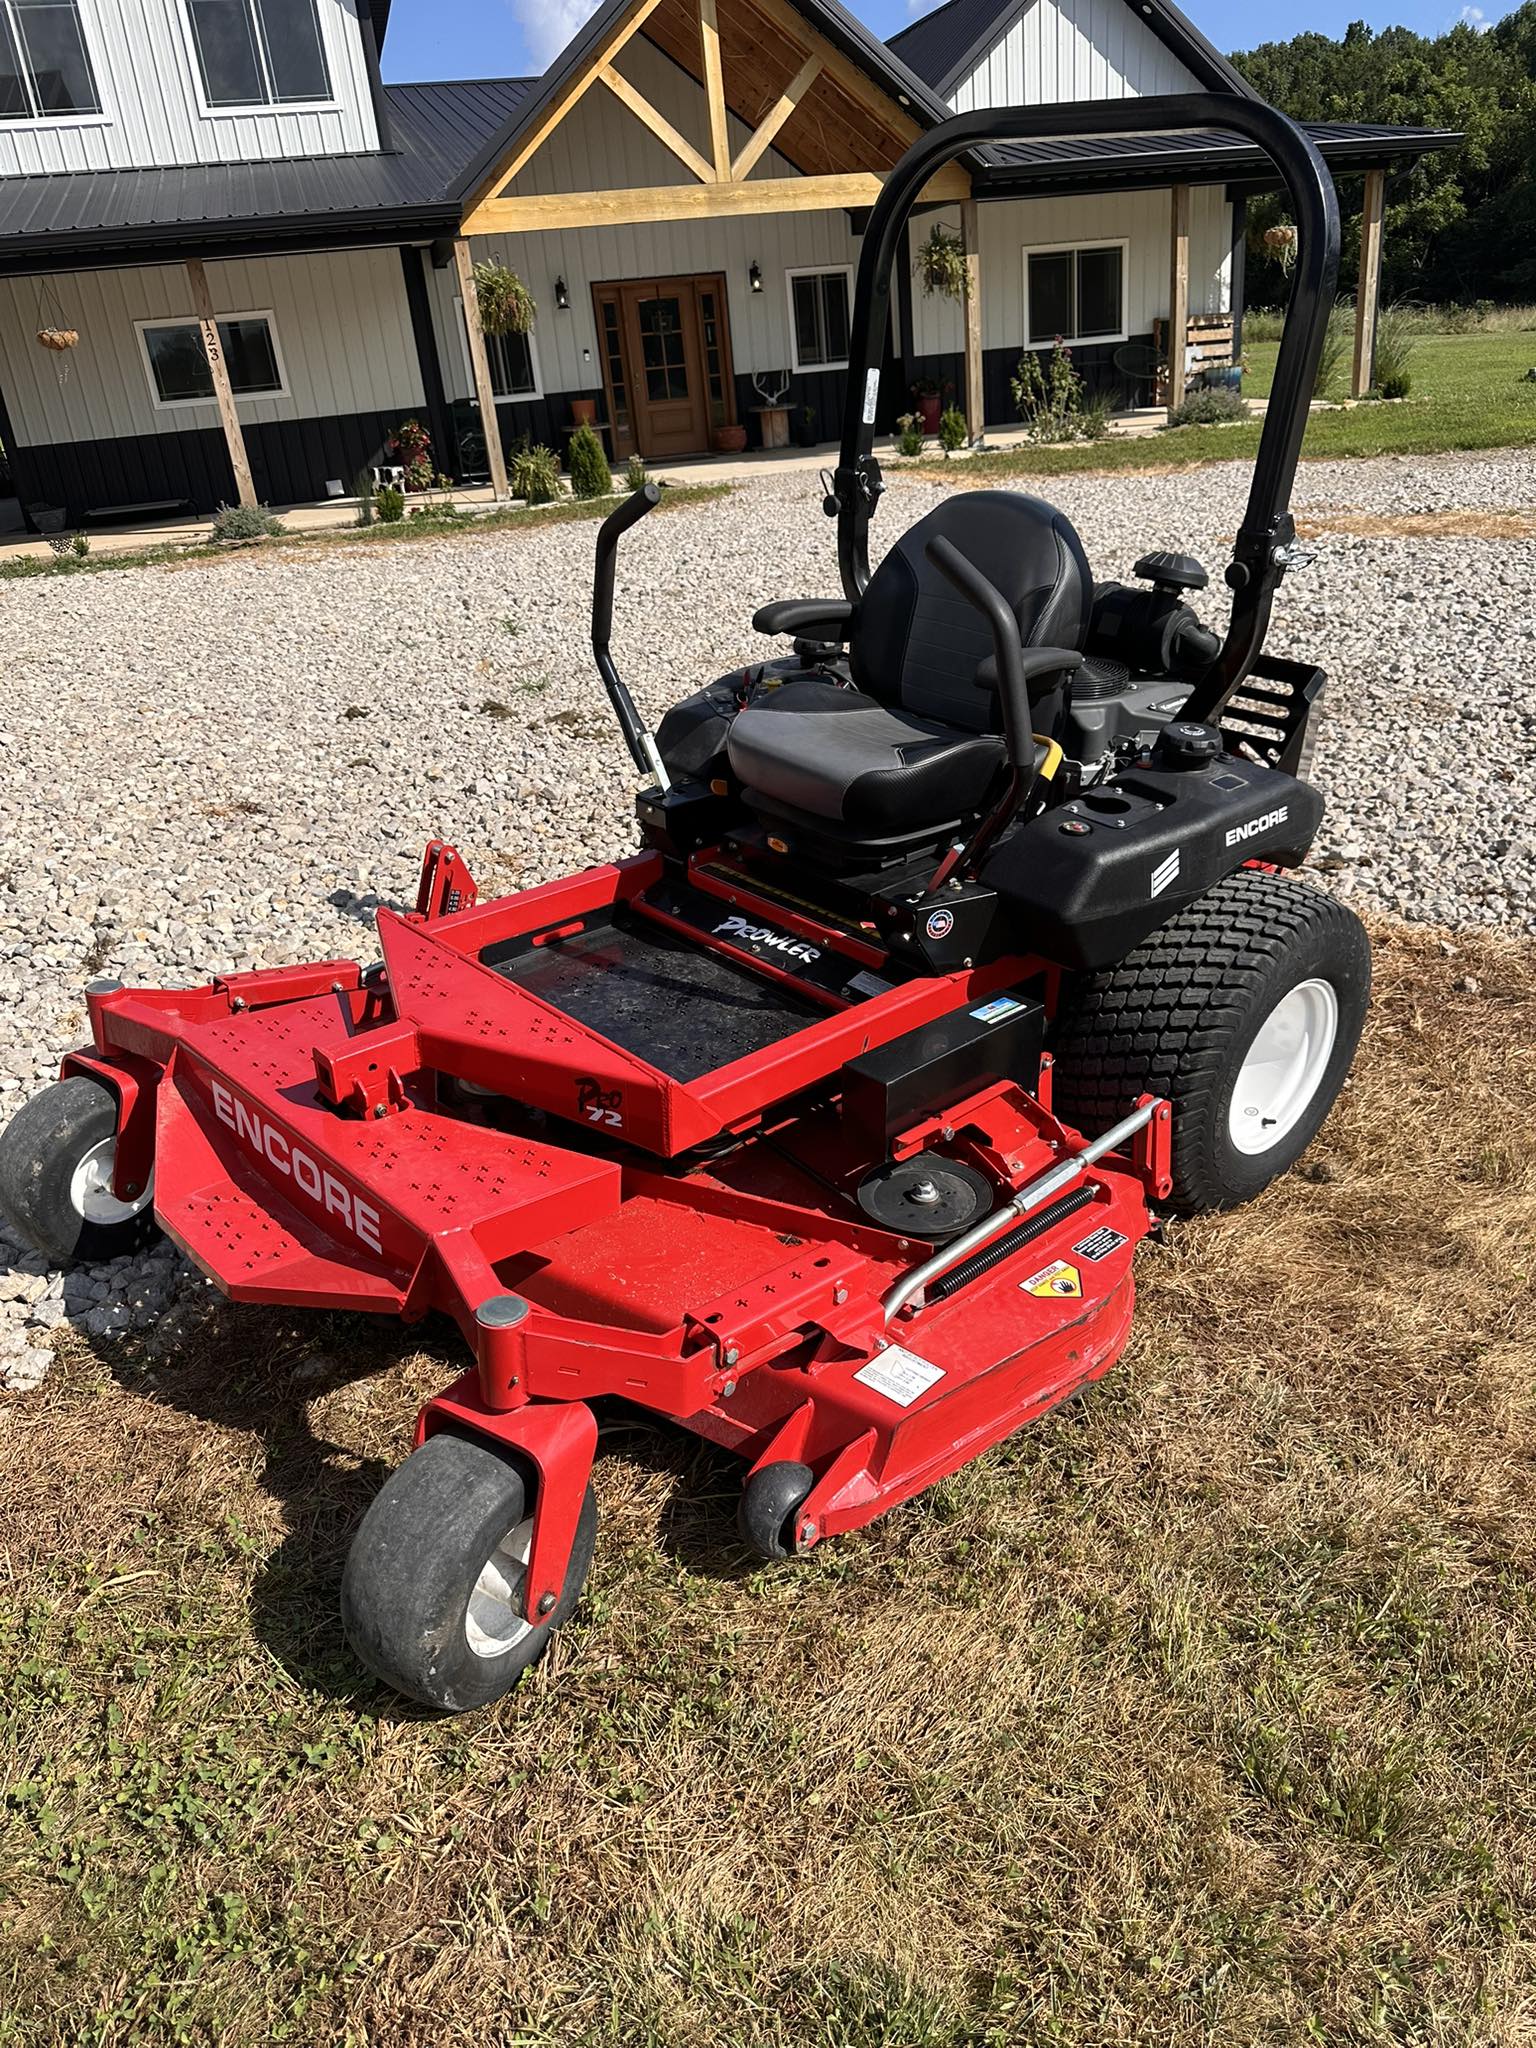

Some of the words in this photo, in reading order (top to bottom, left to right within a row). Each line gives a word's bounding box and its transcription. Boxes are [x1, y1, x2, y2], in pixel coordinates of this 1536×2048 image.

[204, 319, 220, 361] 123
[1225, 806, 1289, 847] ENCORE
[711, 916, 821, 963] PROWLER
[586, 1105, 623, 1127] 72
[211, 1080, 383, 1255] ENCORE
[1028, 1265, 1060, 1286] DANGER
